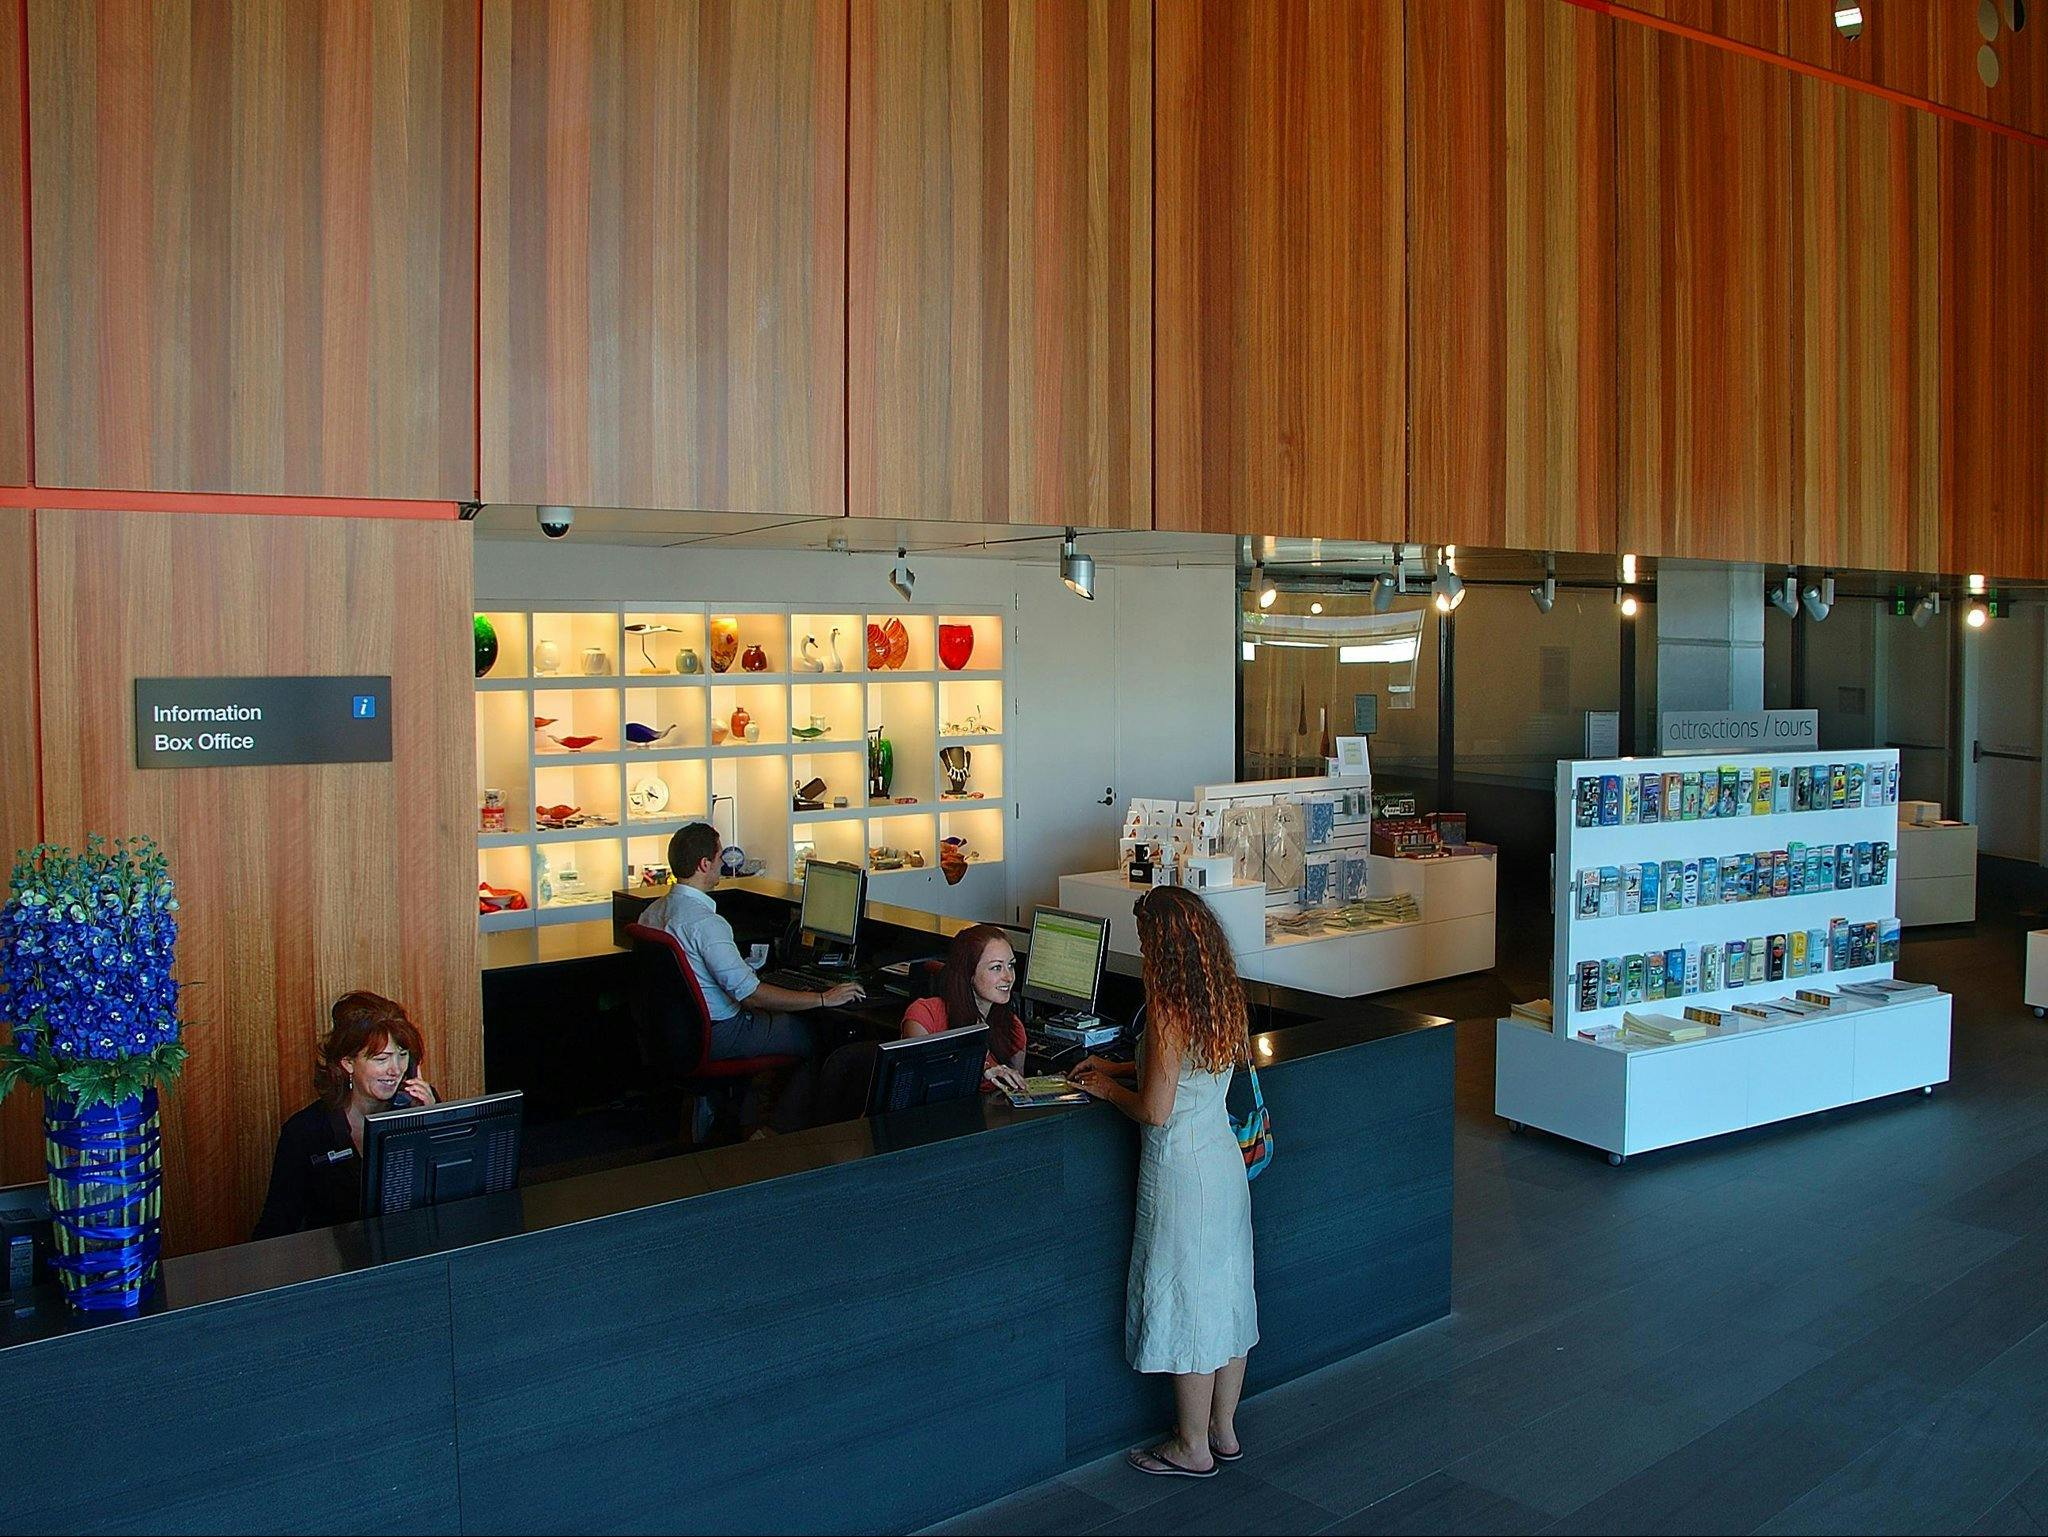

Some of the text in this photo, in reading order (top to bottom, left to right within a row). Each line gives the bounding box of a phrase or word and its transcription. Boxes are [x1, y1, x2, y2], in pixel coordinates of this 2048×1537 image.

[154, 704, 262, 722] Information
[1669, 714, 1812, 740] attractions / tours
[155, 733, 254, 751] Box Office
